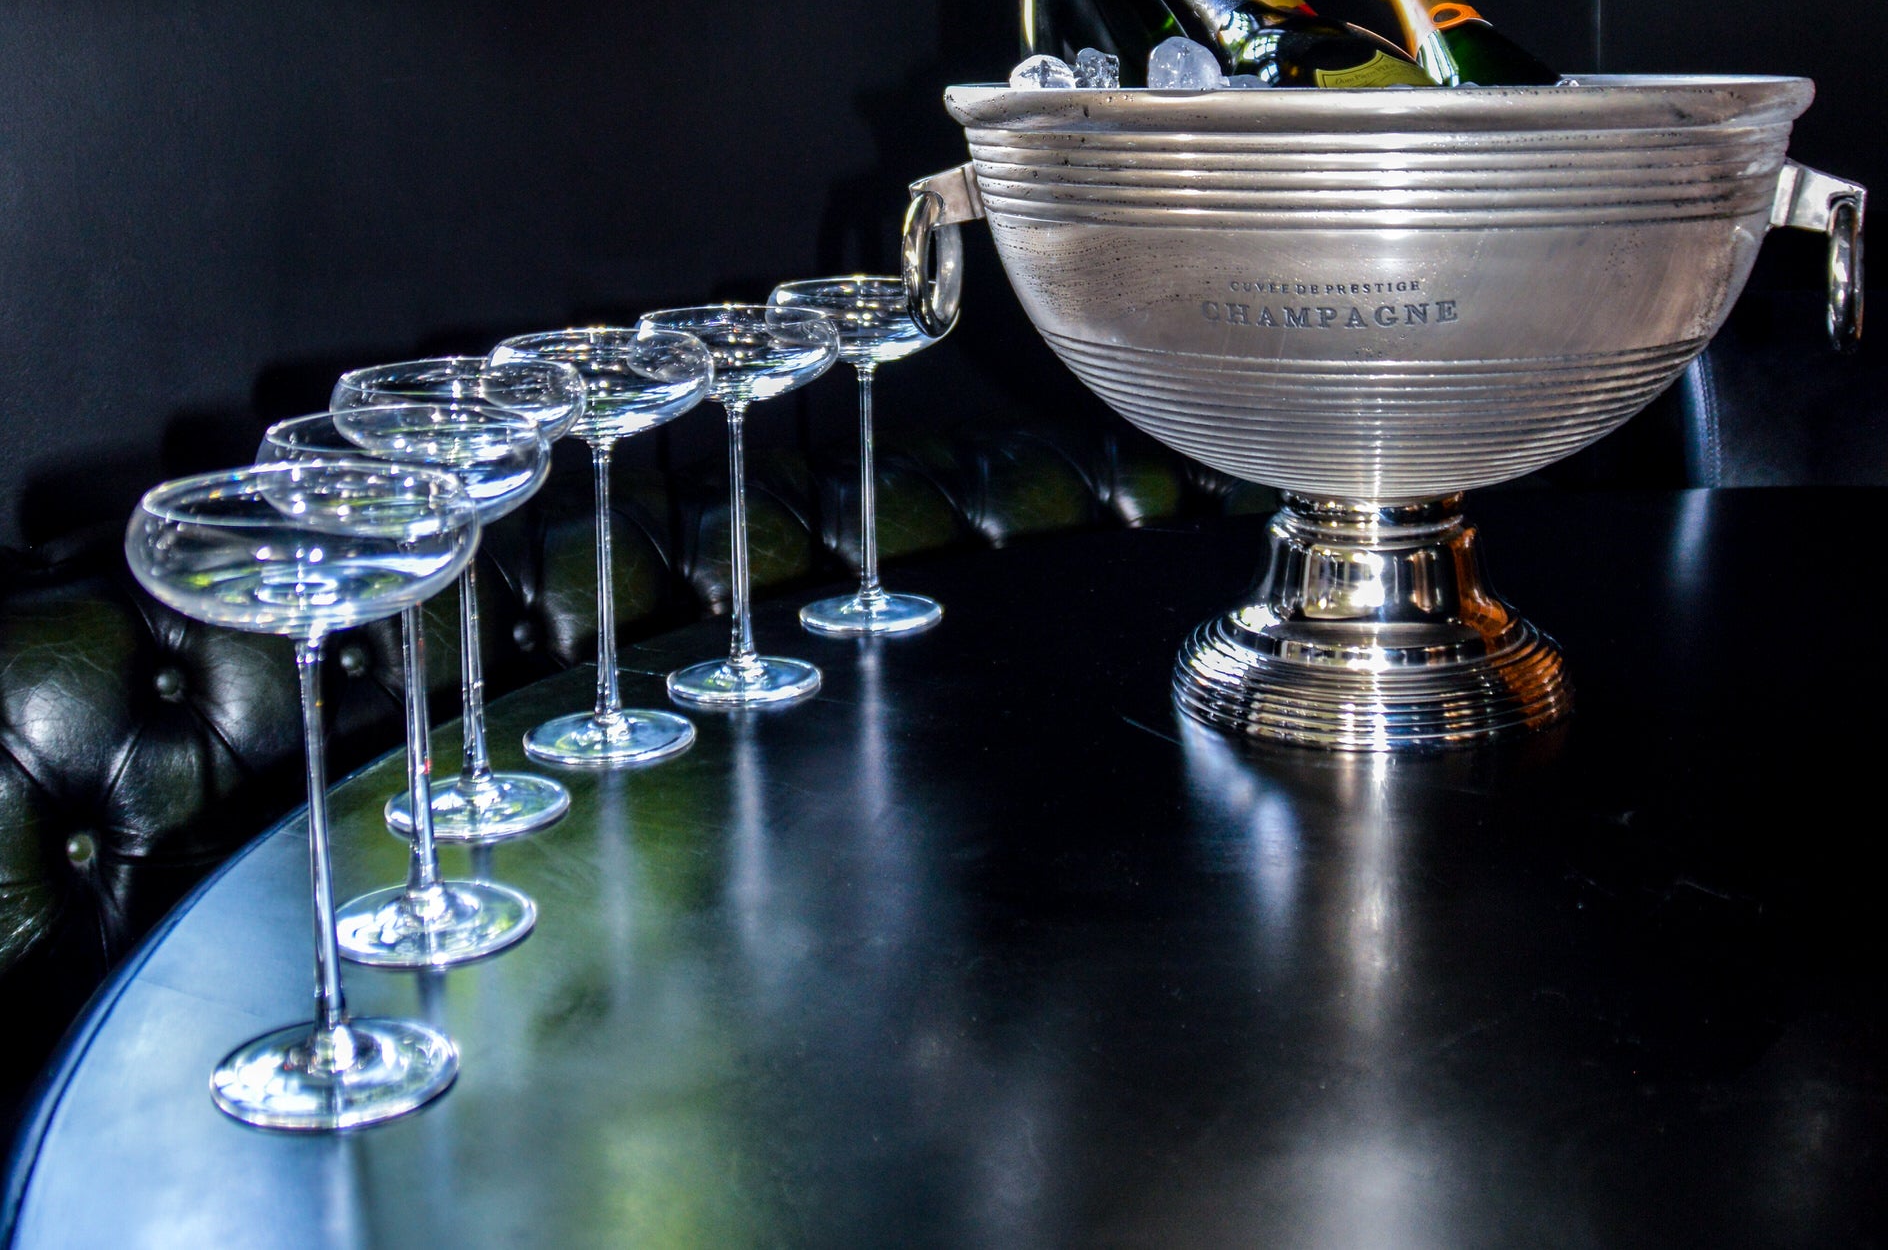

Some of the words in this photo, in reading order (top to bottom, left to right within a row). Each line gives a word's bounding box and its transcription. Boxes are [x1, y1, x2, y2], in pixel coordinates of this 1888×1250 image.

[1295, 283, 1320, 295] DE
[1325, 281, 1421, 295] PRESTIGE
[1201, 300, 1460, 329] CHAMPAGNE
